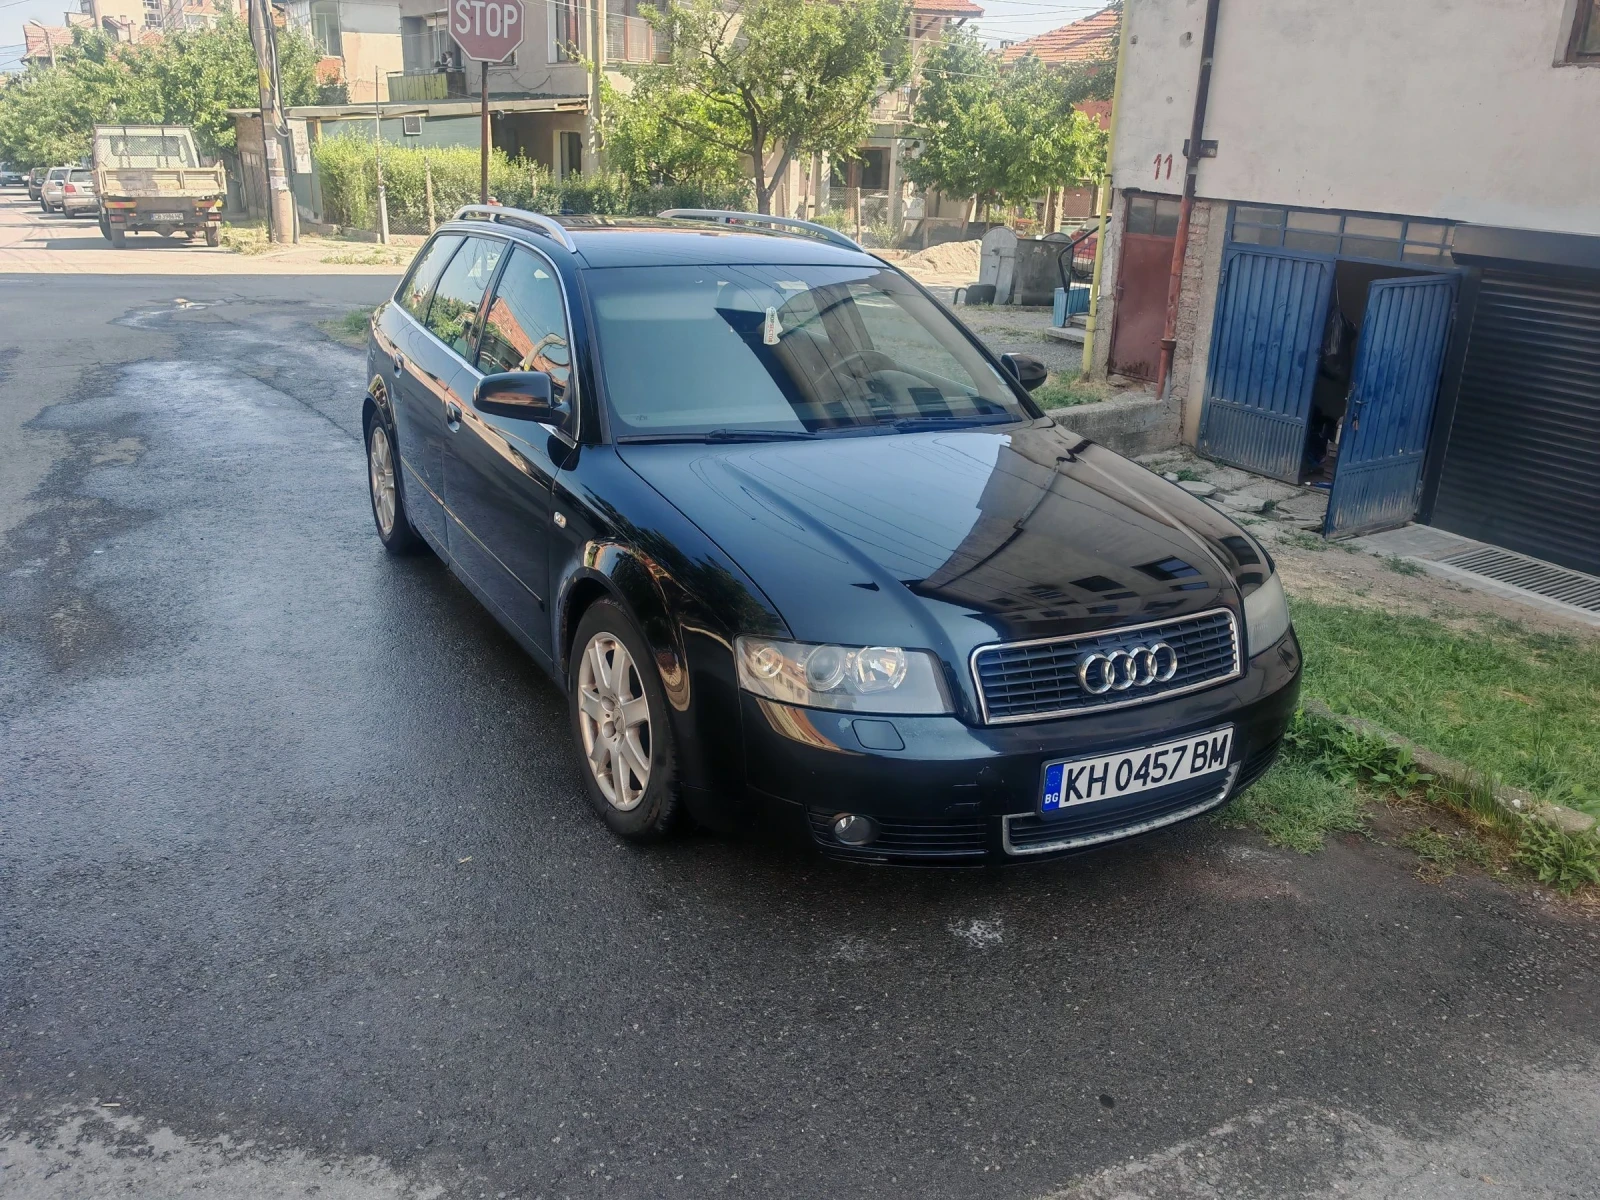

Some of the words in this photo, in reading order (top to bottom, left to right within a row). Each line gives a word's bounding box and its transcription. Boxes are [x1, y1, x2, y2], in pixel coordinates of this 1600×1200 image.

[455, 0, 518, 38] STOP
[1153, 153, 1173, 180] 11
[1064, 762, 1109, 803] KH
[1115, 745, 1188, 792] 0457
[1190, 734, 1229, 774] BM
[1045, 792, 1059, 804] BG
